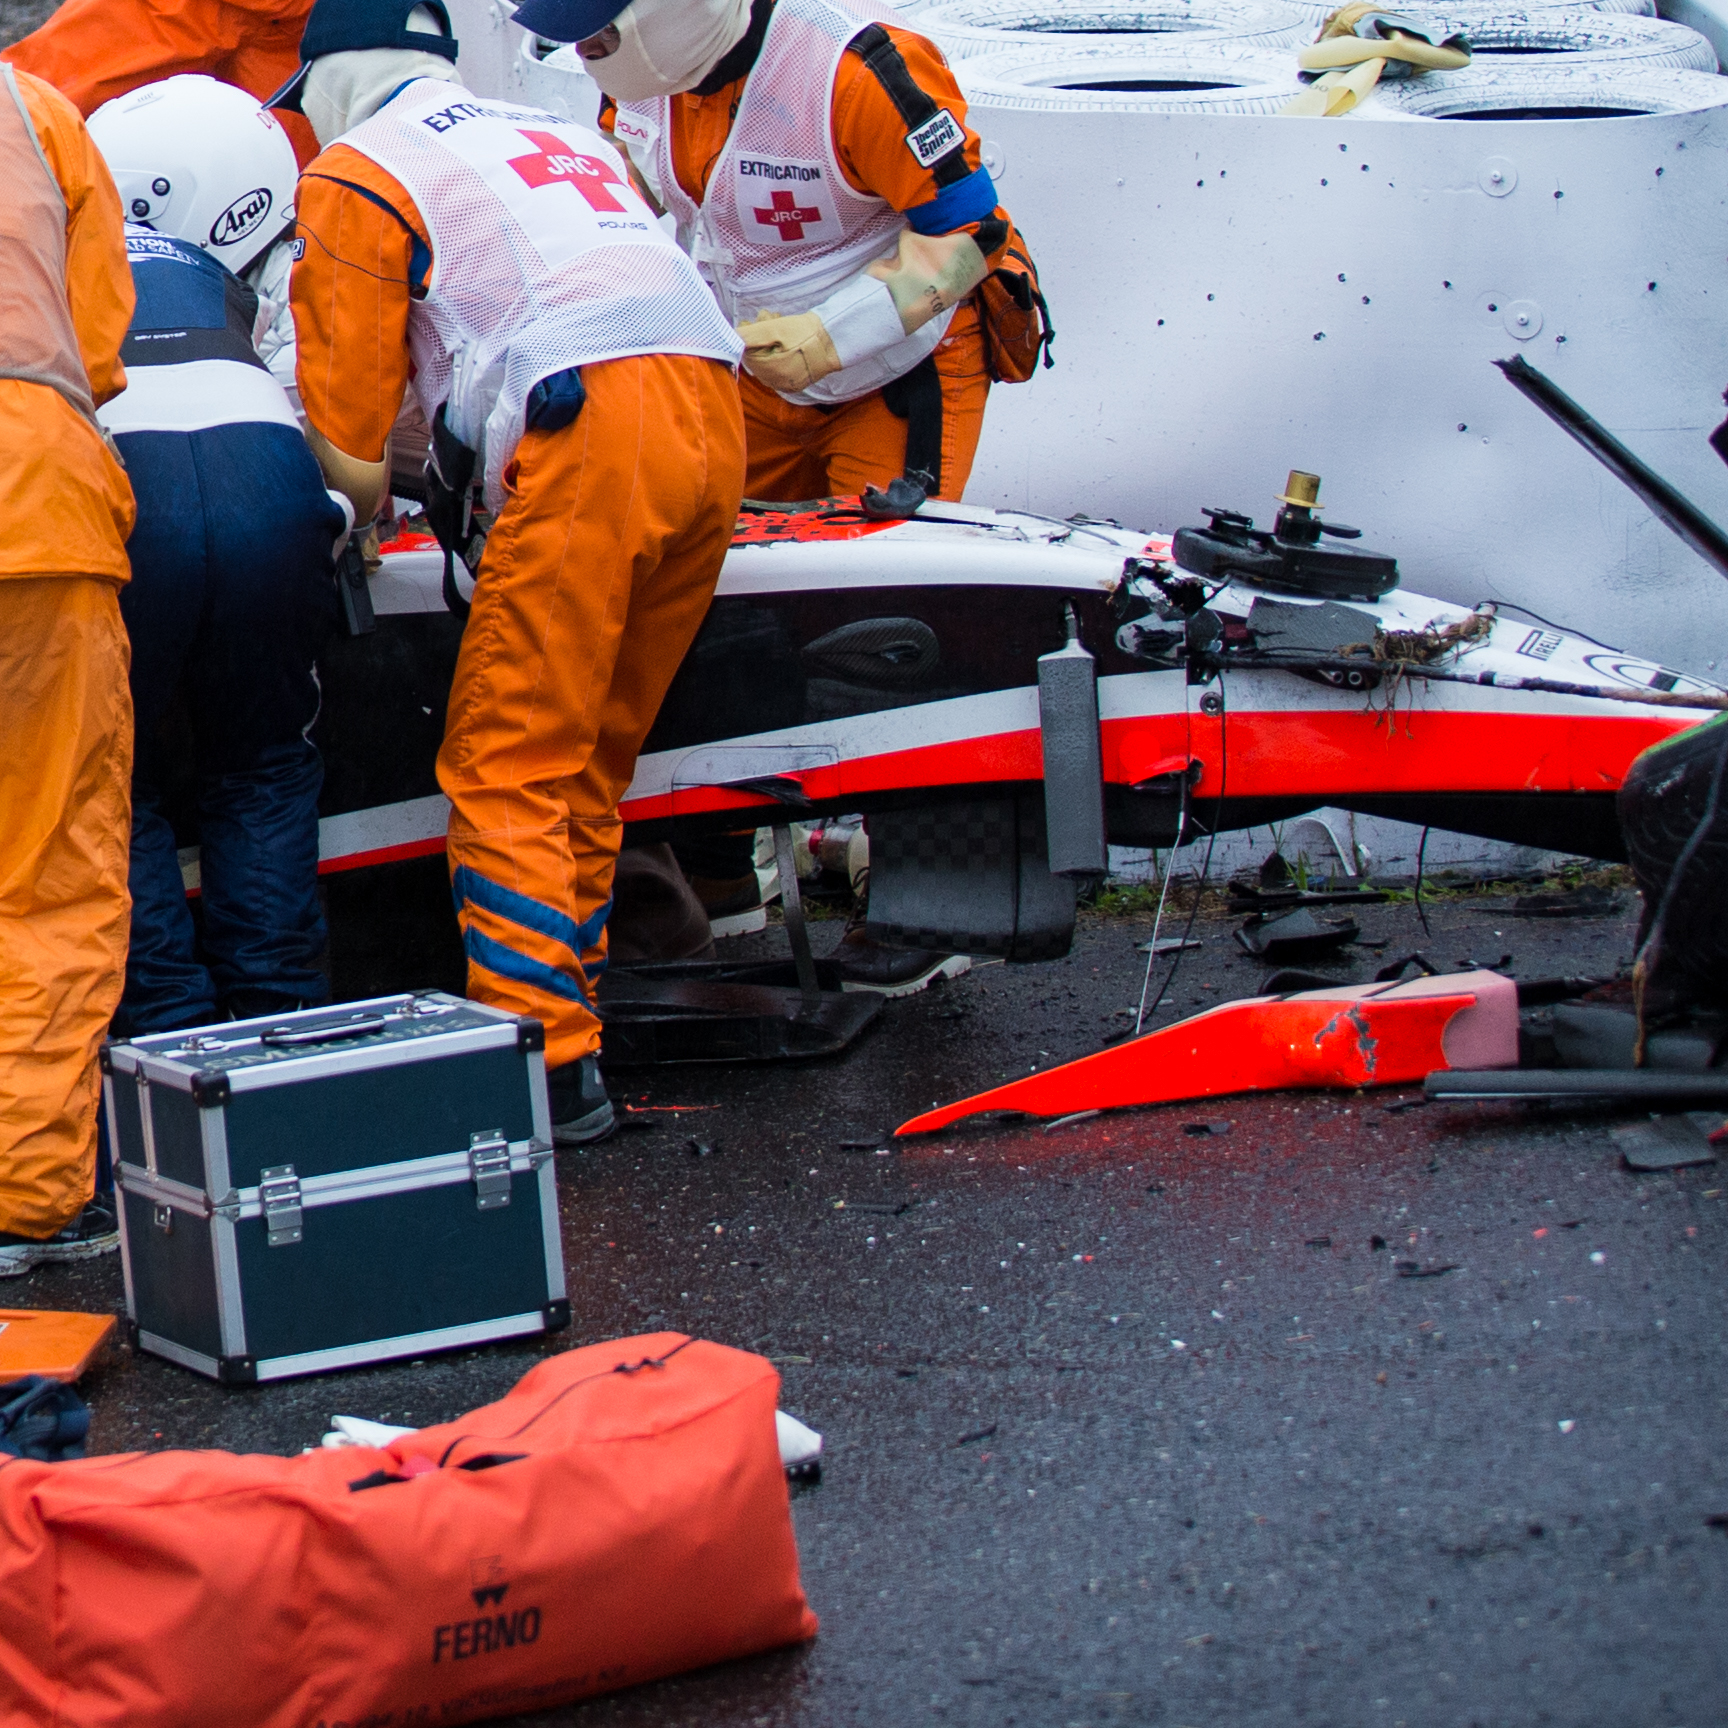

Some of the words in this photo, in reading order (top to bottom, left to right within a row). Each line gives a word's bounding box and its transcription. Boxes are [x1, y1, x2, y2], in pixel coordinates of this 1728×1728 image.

[547, 154, 600, 176] JRC
[740, 160, 822, 182] EXTRICATION
[221, 191, 267, 242] Arai
[770, 210, 803, 223] JRC
[432, 1606, 542, 1665] FERNO
